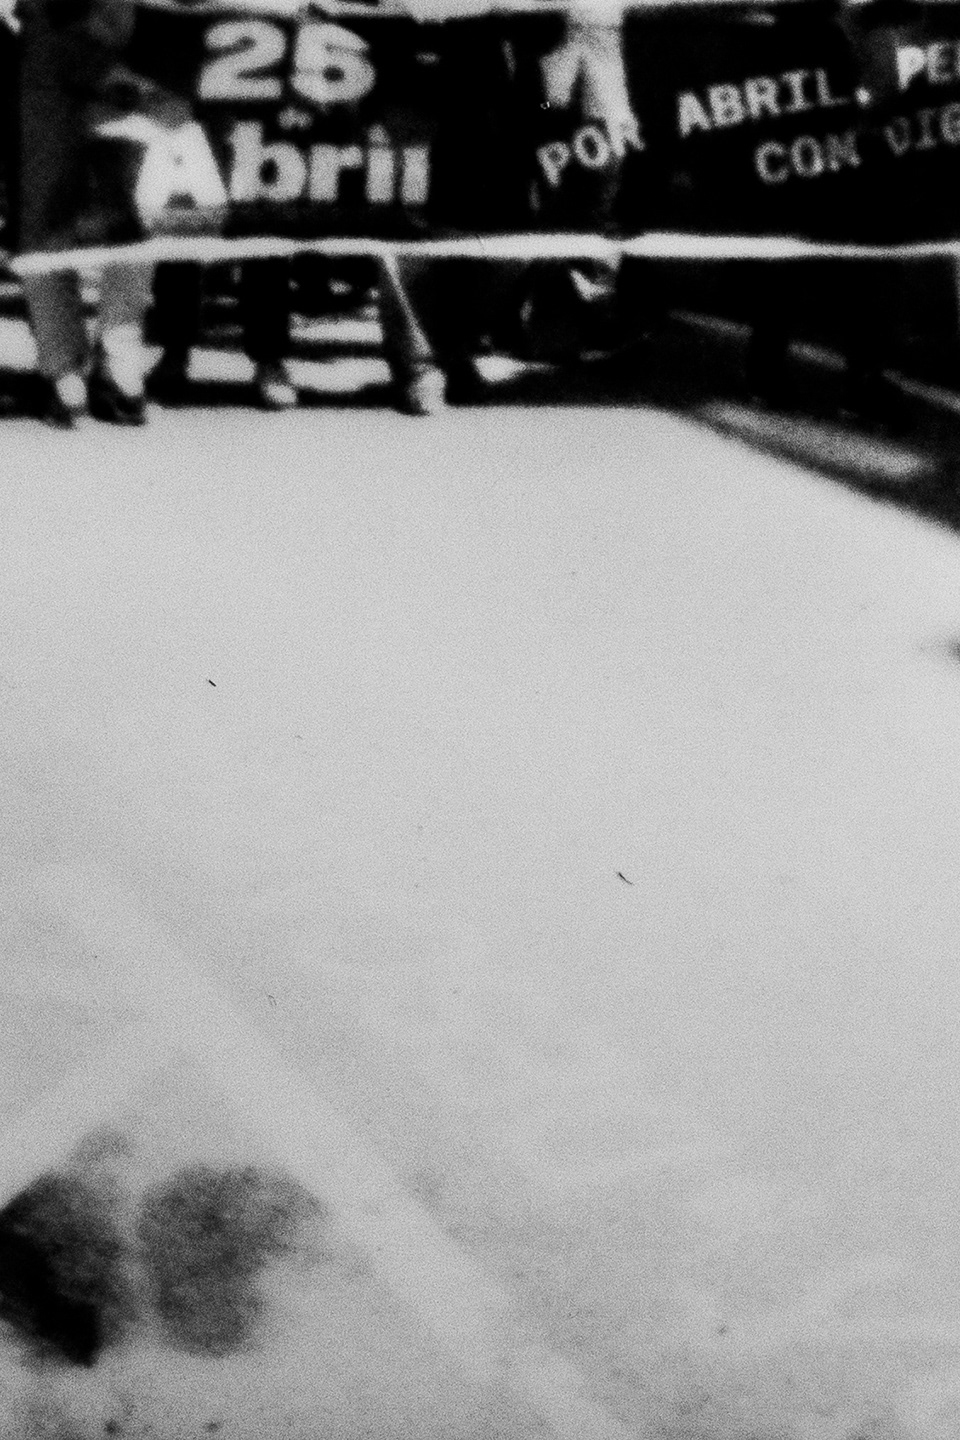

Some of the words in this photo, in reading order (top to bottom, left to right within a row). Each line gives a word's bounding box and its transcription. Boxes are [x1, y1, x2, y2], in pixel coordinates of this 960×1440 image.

[136, 121, 429, 204] Abril
[535, 114, 647, 188] POR
[754, 130, 861, 184] COM
